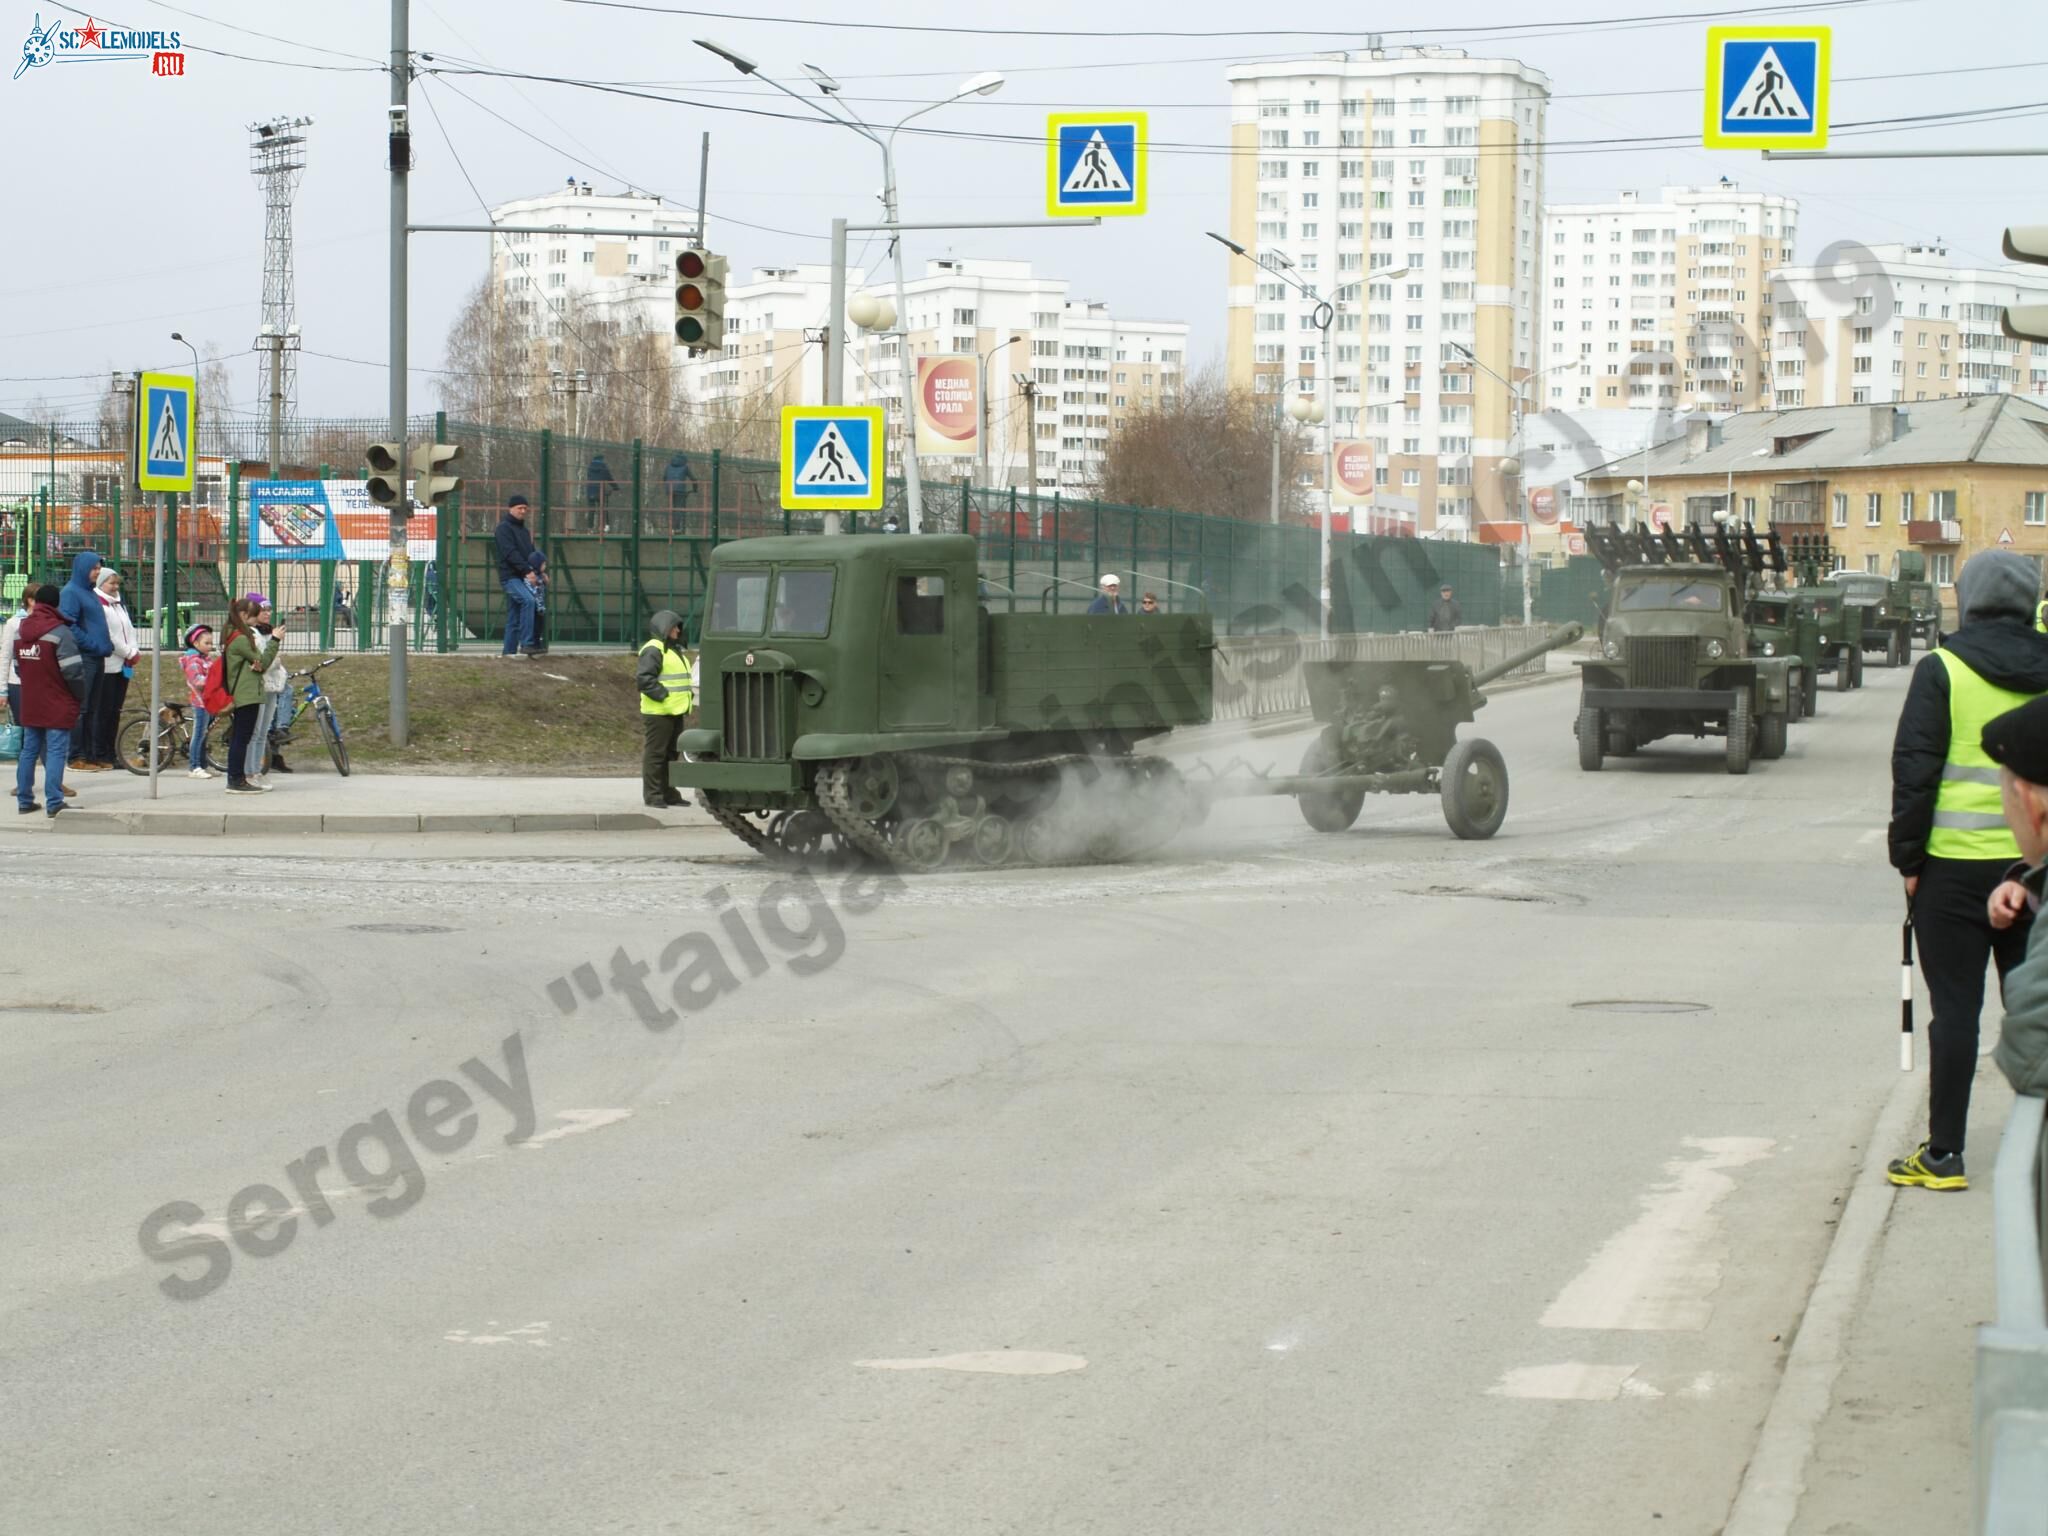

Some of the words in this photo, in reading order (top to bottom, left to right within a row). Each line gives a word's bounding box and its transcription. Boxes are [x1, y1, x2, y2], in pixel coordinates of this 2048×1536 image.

[935, 378, 970, 389] МЕДНАЯ
[935, 390, 973, 401] СТОЛИЦА
[935, 402, 963, 413] УРАЛА
[257, 487, 271, 496] НА
